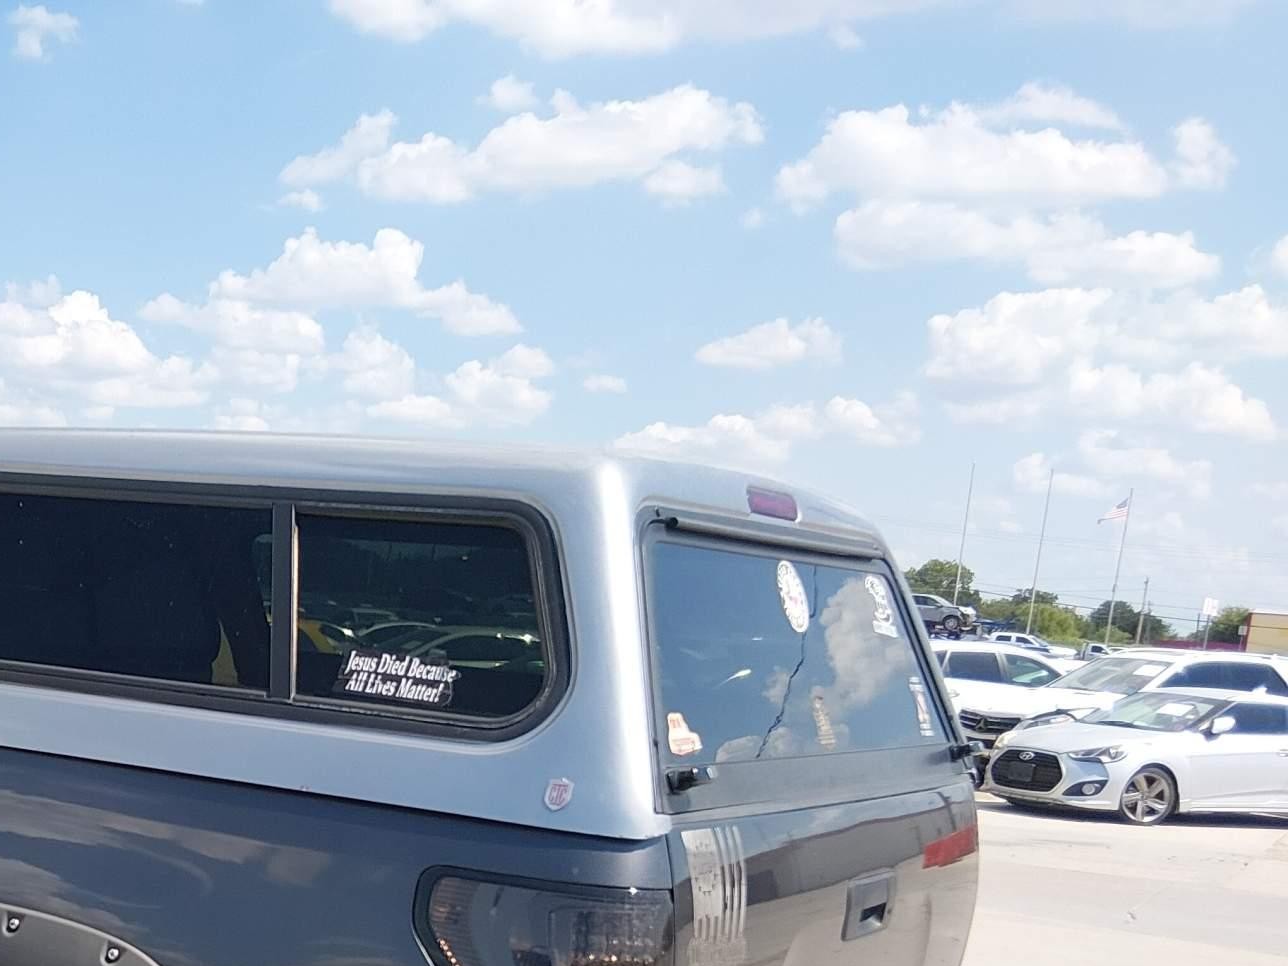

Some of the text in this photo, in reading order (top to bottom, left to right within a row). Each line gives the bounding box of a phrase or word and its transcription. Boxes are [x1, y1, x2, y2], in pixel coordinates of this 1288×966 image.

[344, 650, 457, 683] Jesus Died Because
[345, 671, 445, 703] All Lives Matter!
